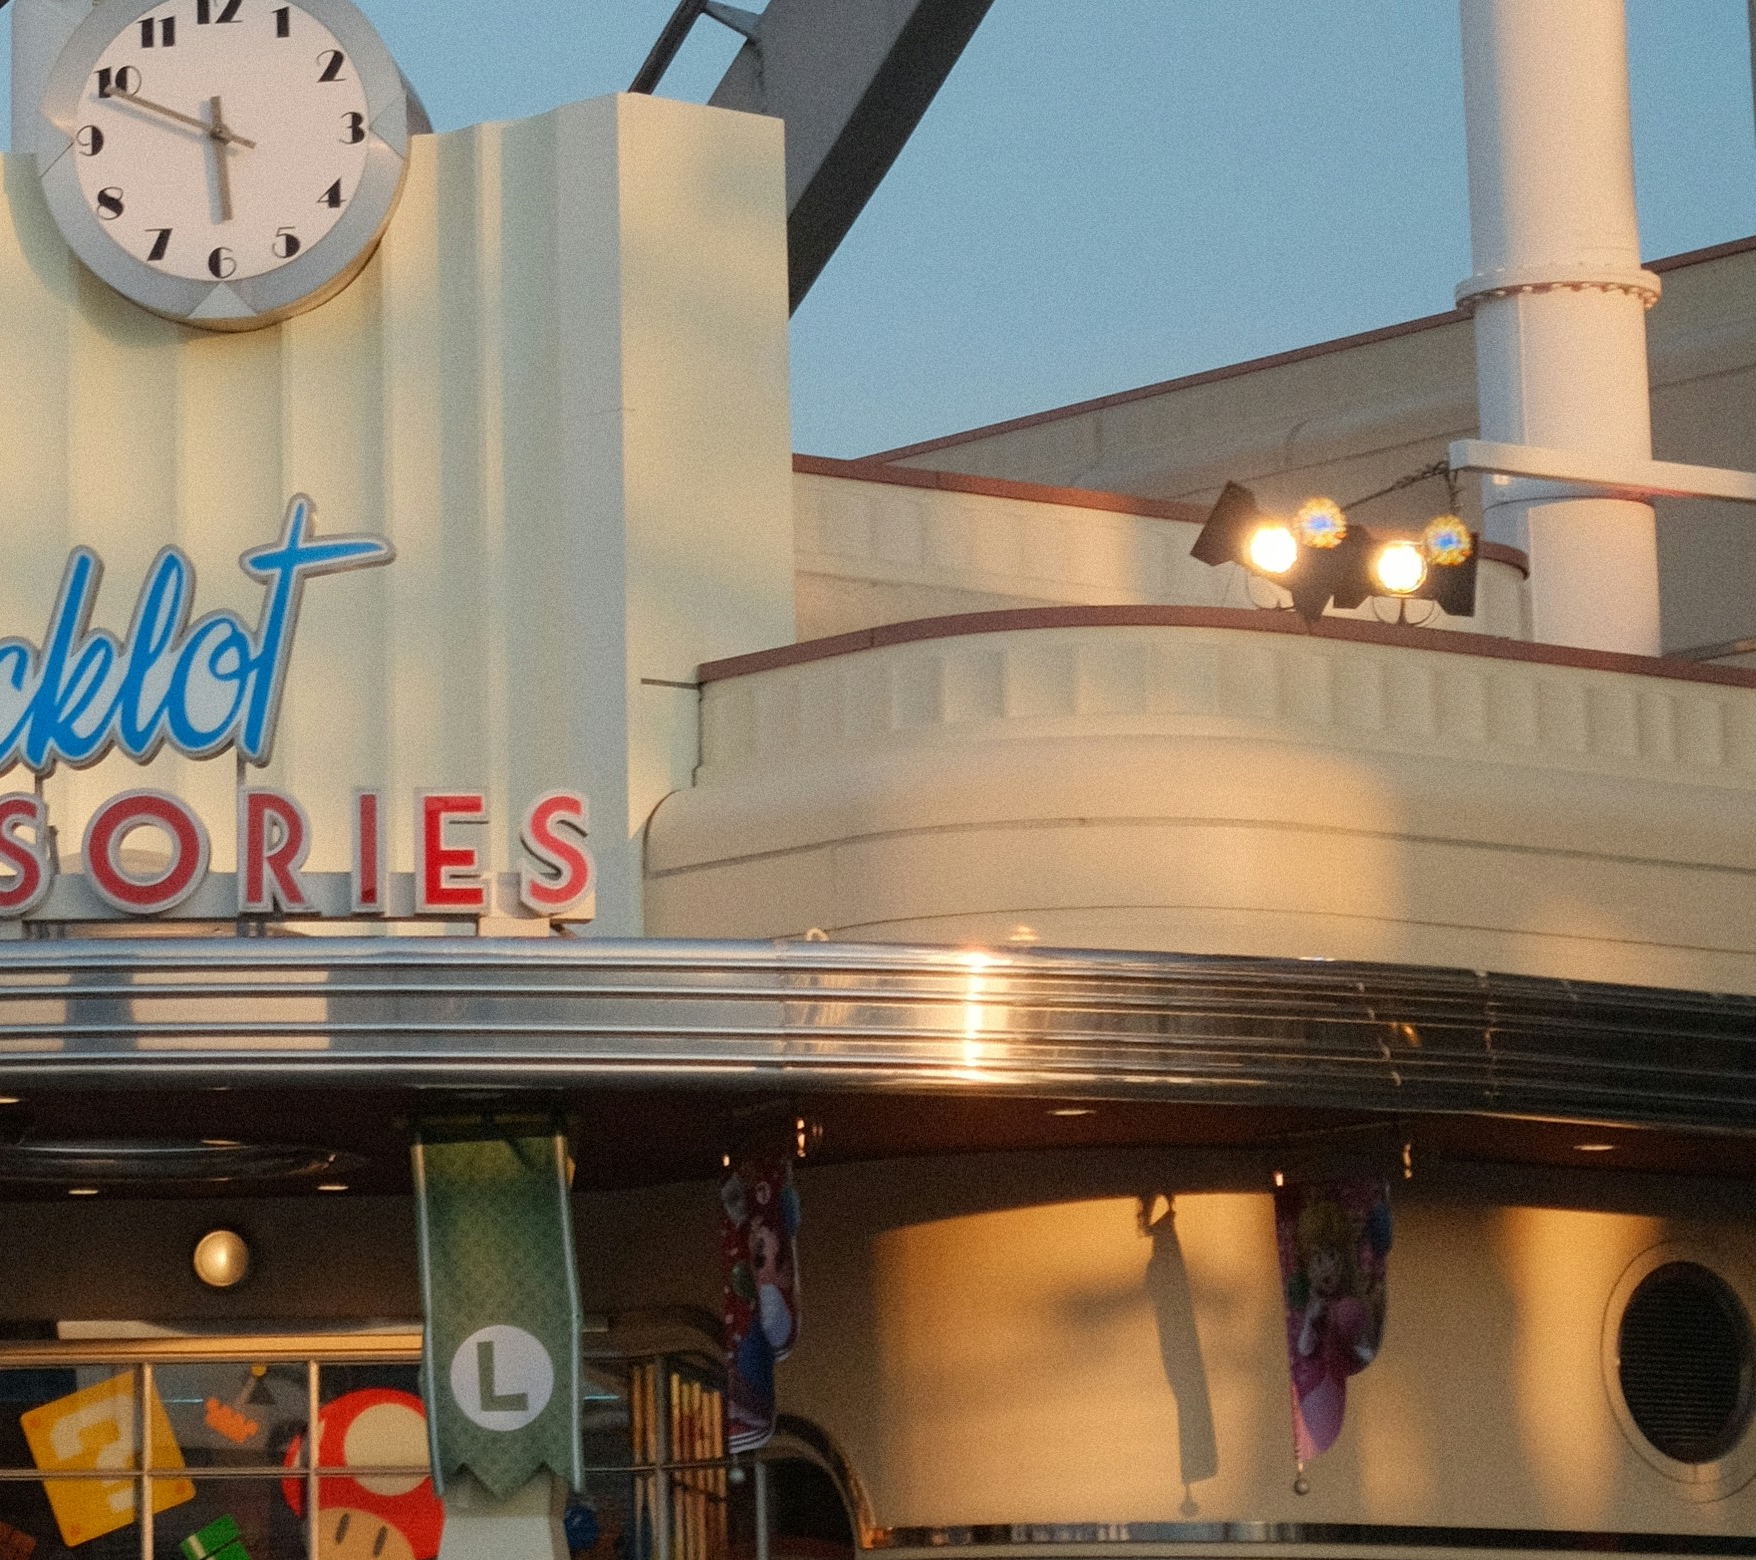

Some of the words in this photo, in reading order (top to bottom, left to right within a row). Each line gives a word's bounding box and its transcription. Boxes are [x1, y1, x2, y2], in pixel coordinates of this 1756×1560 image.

[136, 16, 176, 48] 11
[271, 6, 290, 38] 1
[94, 65, 142, 98] 10
[316, 49, 347, 83] 2
[76, 125, 104, 157] 9
[338, 111, 365, 144] 3
[96, 186, 125, 220] 8
[316, 176, 348, 209] 4
[144, 227, 173, 262] 7
[272, 226, 301, 259] 5
[207, 246, 237, 279] 6
[477, 1341, 529, 1412] L
